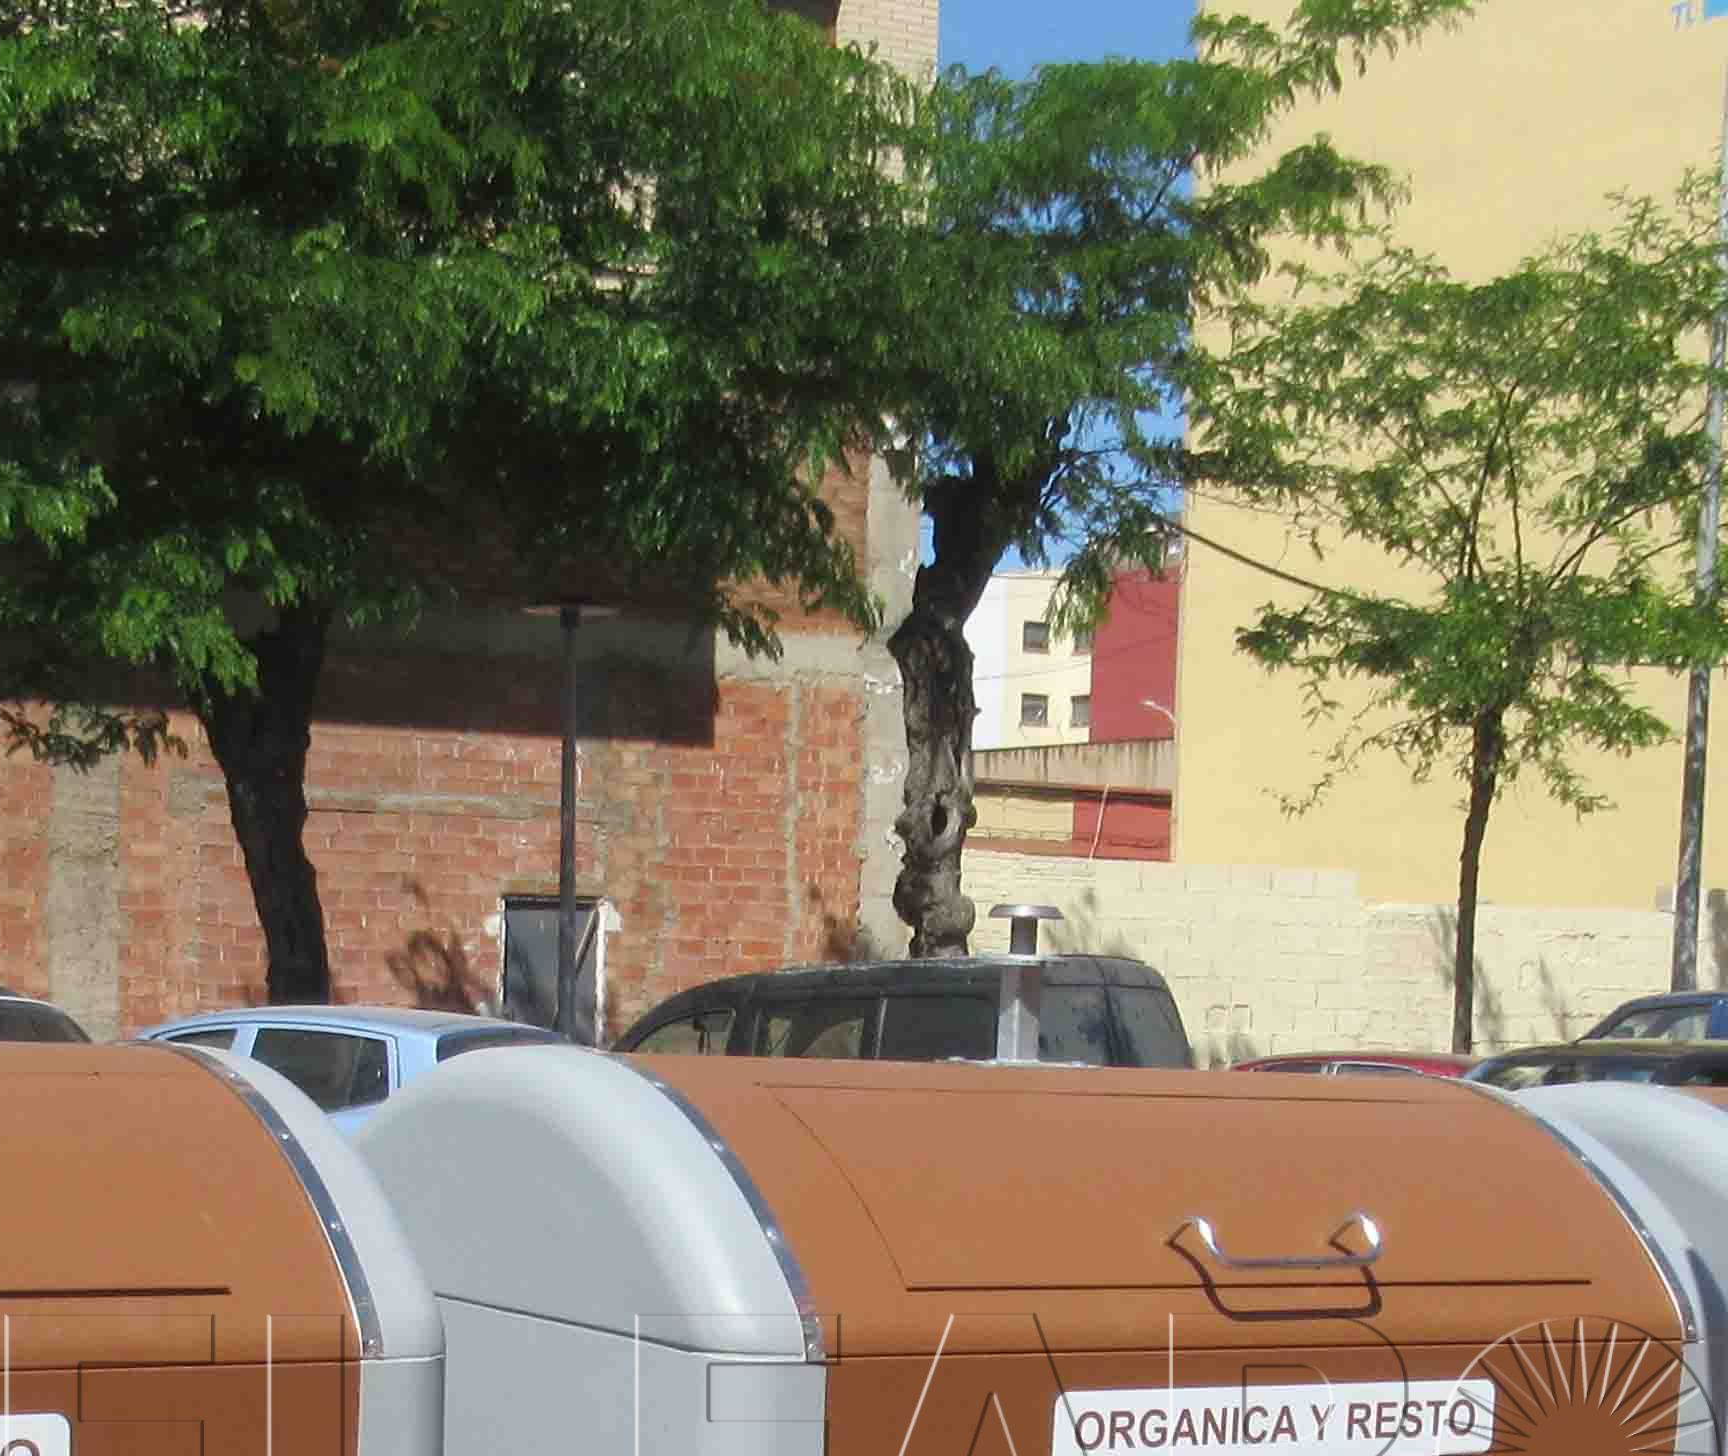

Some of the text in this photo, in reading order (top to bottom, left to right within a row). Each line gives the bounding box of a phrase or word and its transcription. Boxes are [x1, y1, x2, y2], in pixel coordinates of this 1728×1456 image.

[1073, 1398, 1476, 1450] ORGANICA Y RESTO
